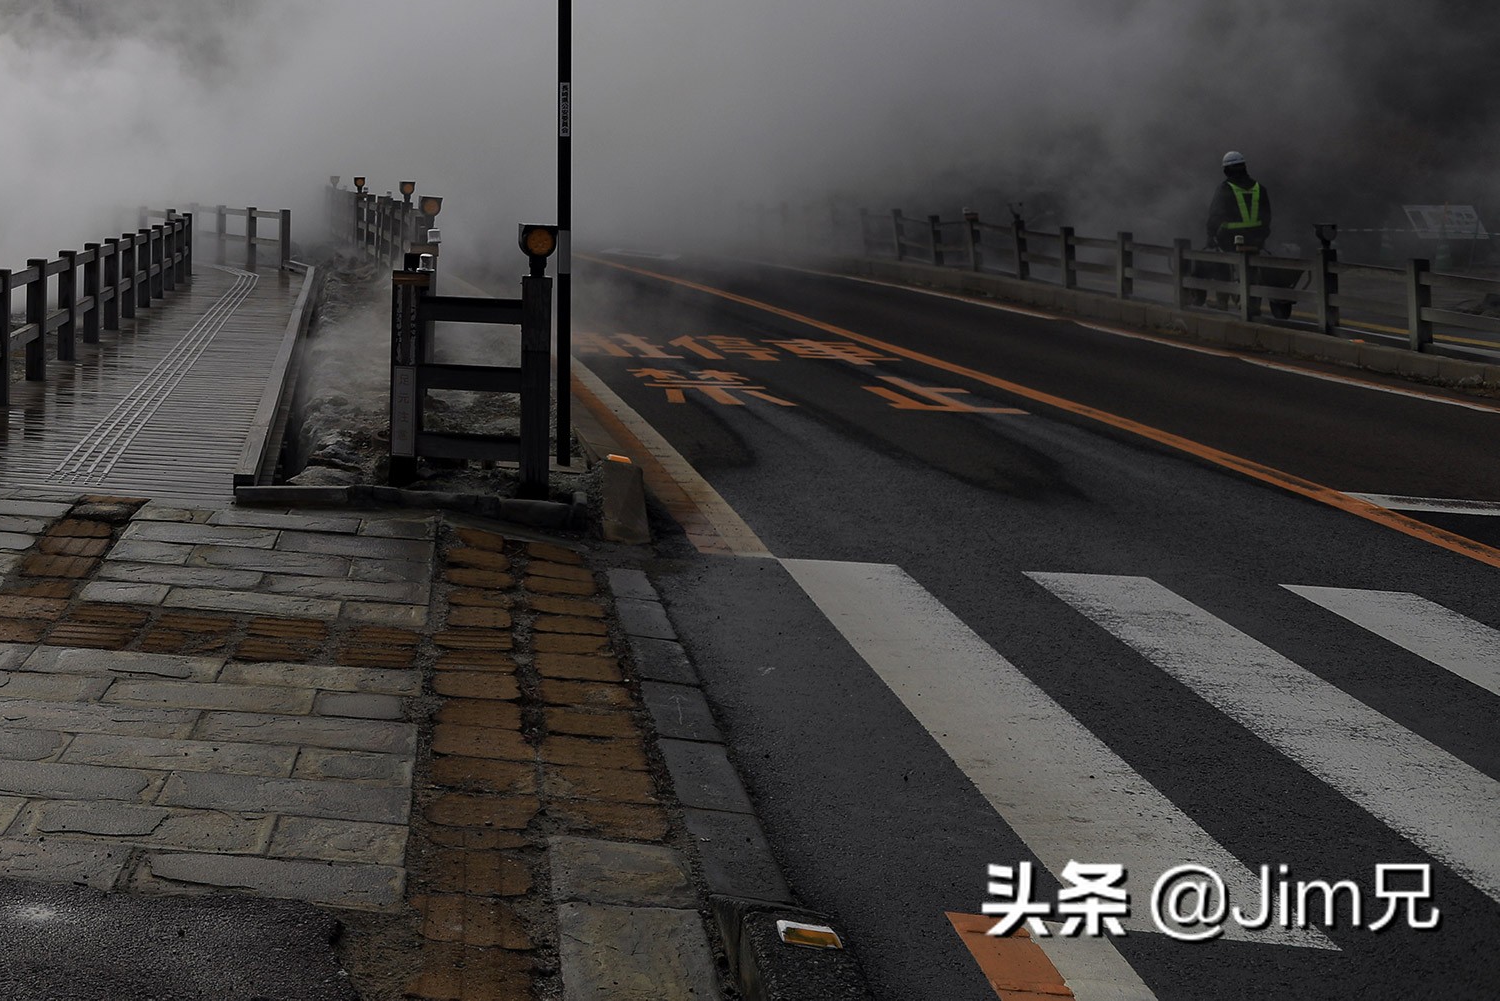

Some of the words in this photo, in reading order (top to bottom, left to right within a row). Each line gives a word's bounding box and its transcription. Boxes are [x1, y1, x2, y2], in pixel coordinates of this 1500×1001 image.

[572, 332, 903, 366] 駐停車
[626, 367, 1031, 415] 禁止
